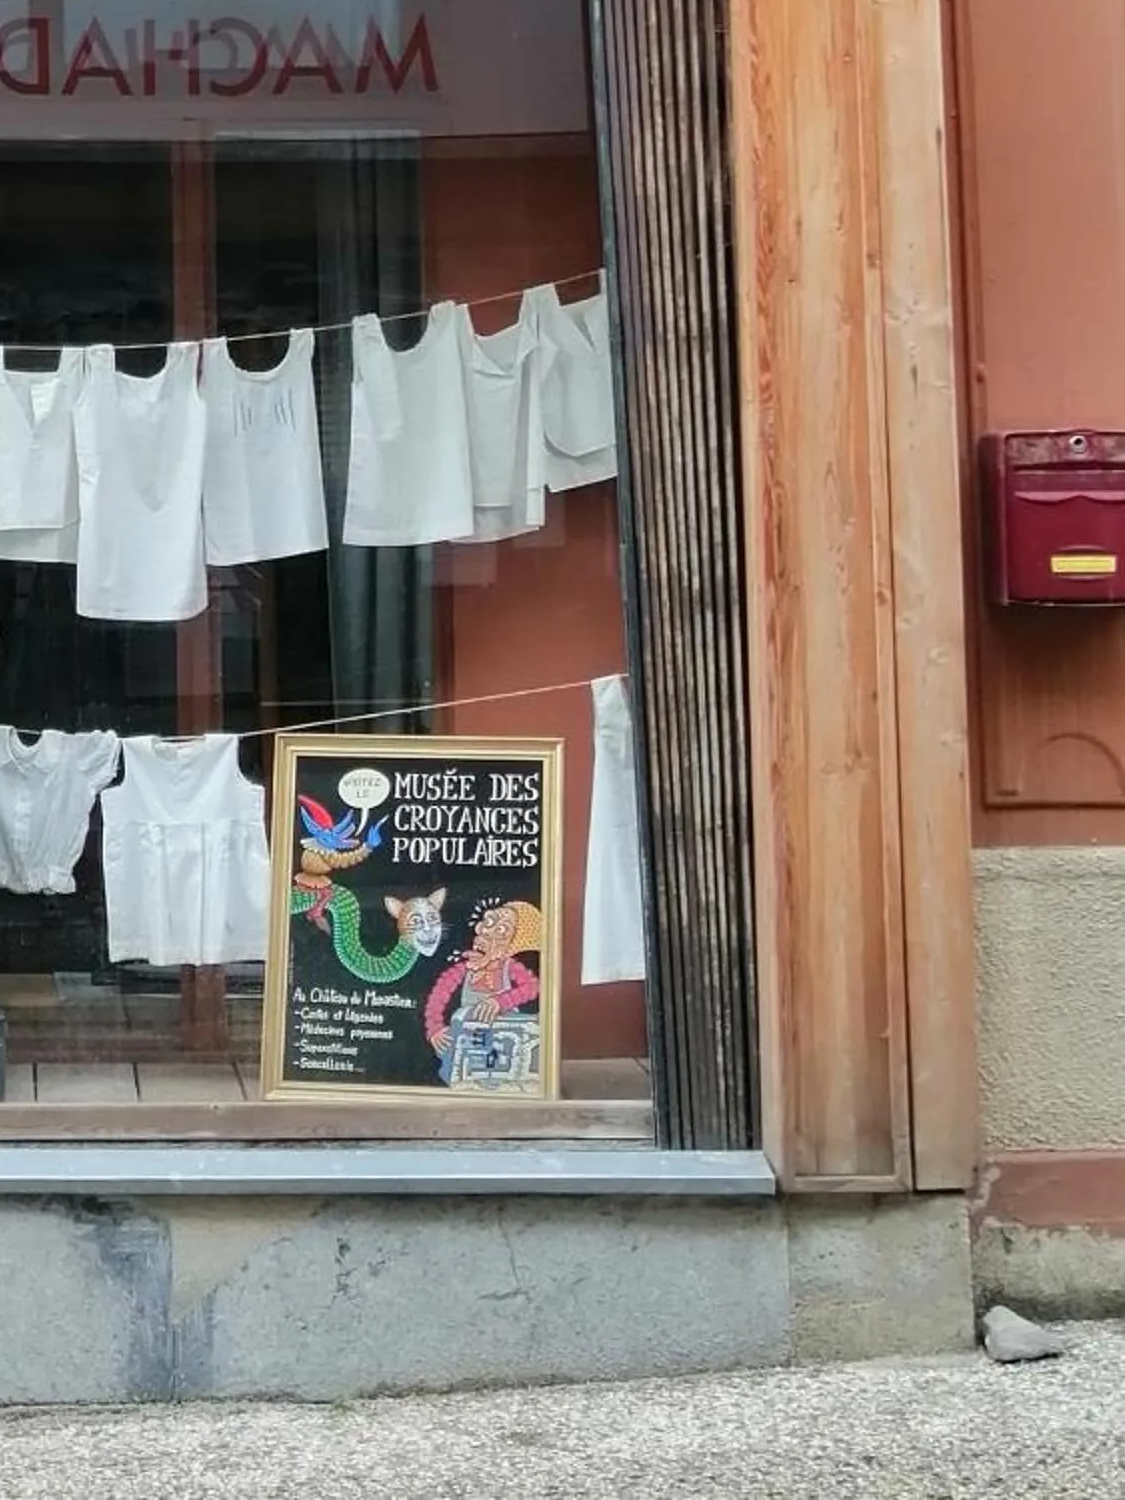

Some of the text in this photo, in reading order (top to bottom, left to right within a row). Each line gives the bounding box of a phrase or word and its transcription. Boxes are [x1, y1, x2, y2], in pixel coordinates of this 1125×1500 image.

[394, 767, 540, 801] MUSÉE DES
[394, 804, 540, 835] CROYANCES
[392, 835, 538, 867] POPULAIRES
